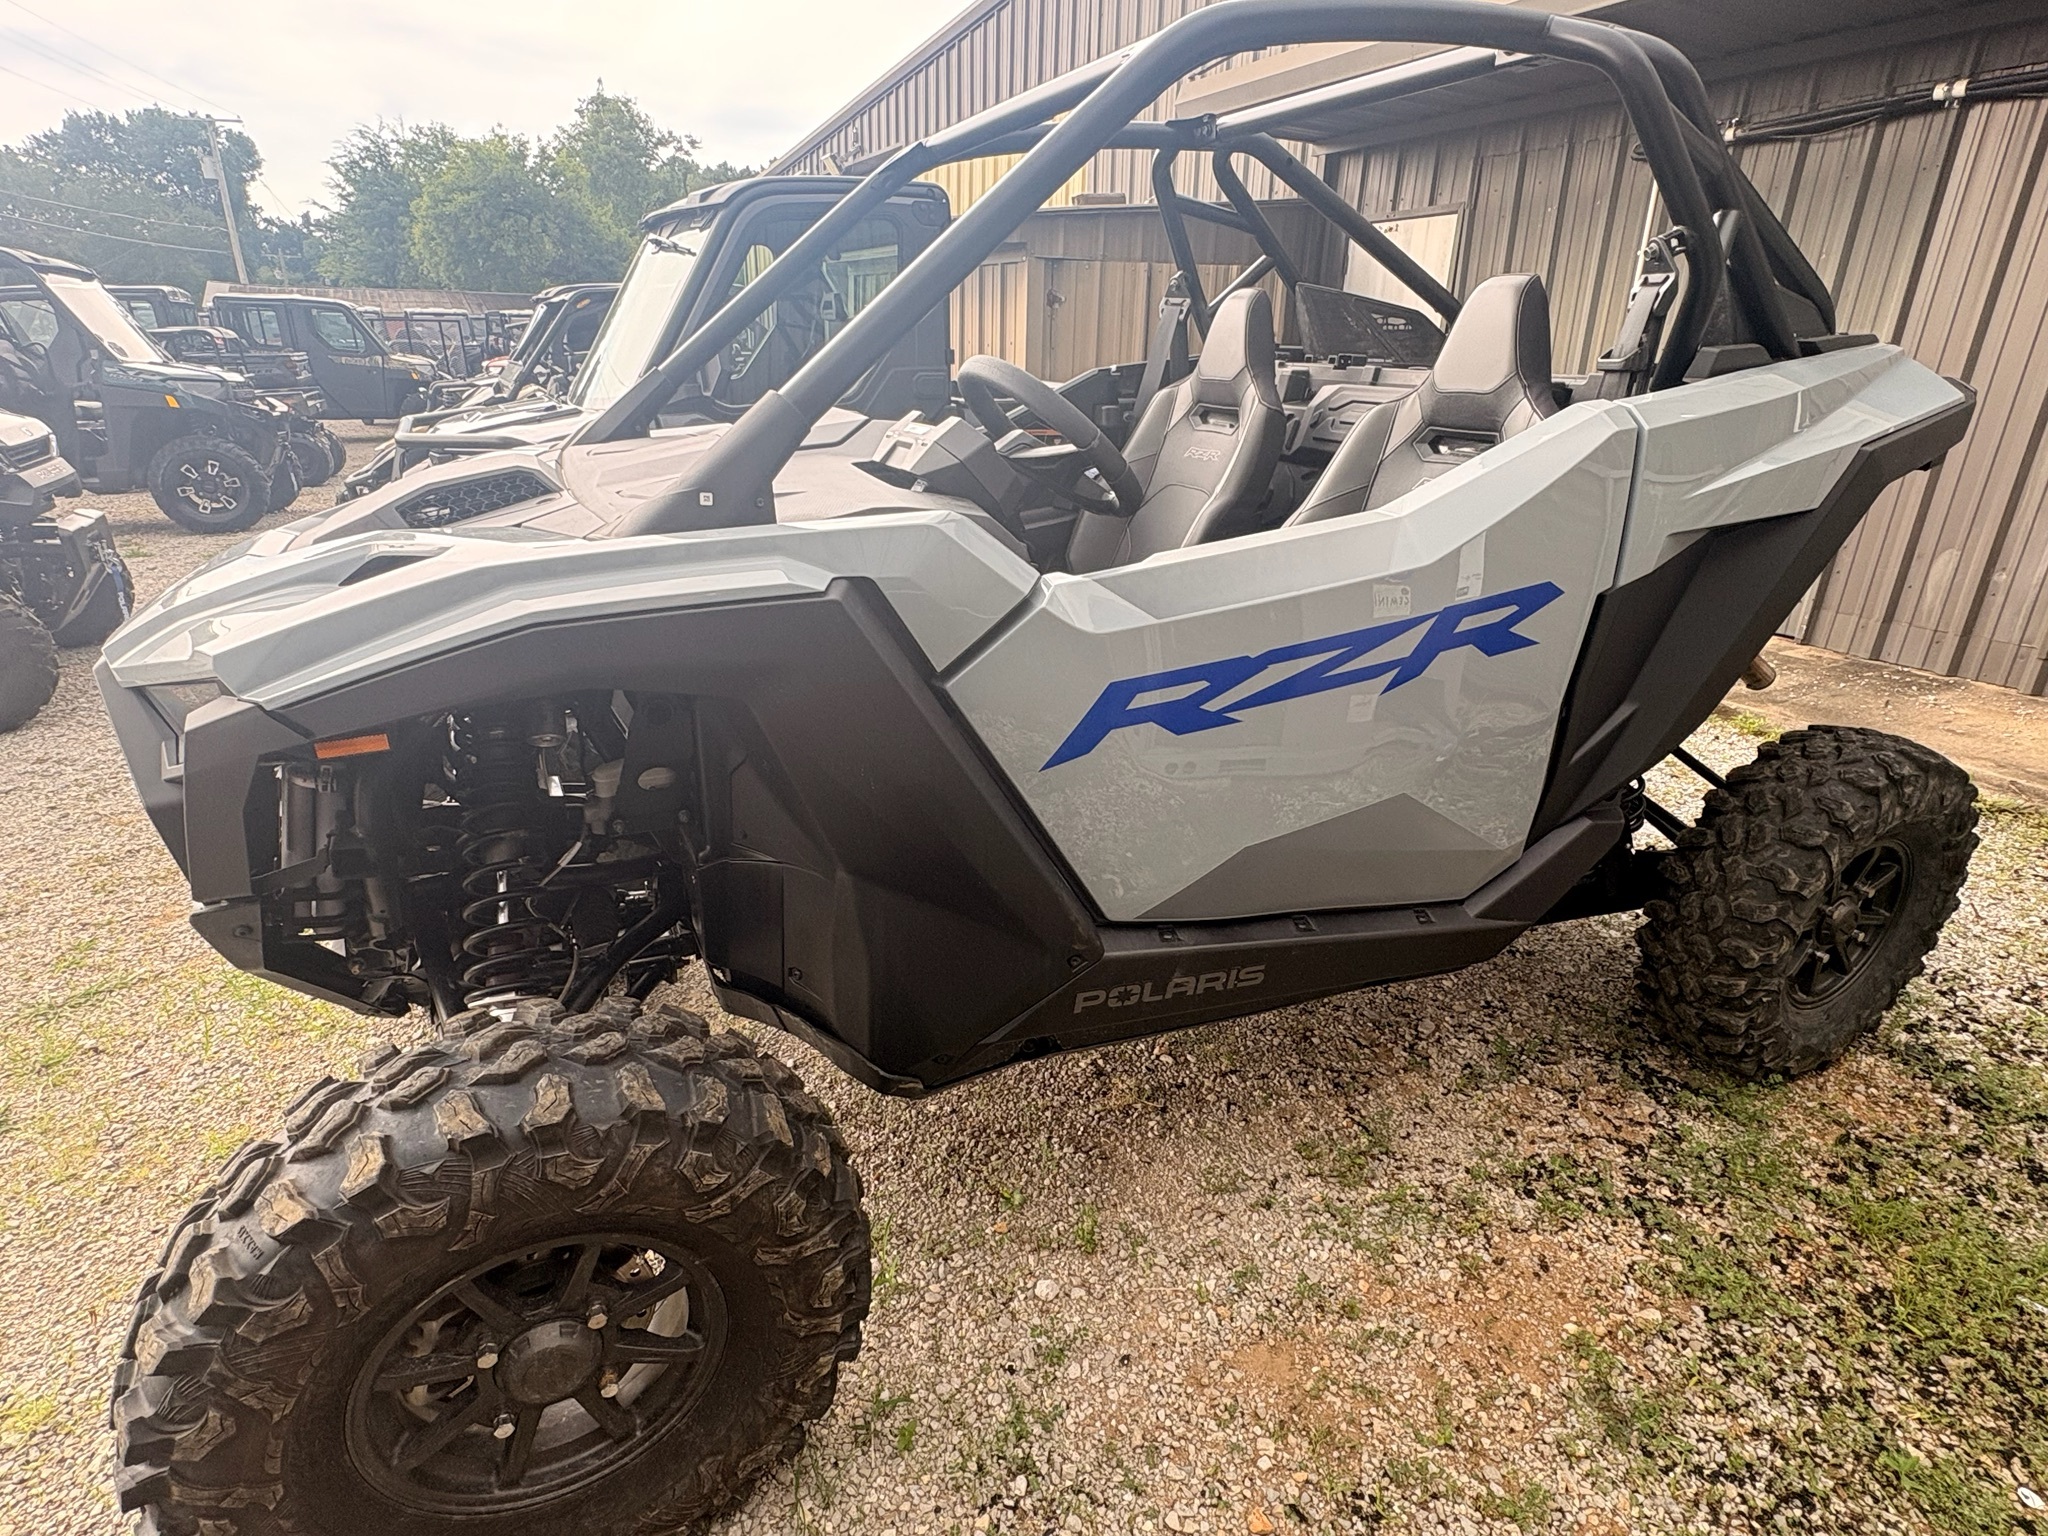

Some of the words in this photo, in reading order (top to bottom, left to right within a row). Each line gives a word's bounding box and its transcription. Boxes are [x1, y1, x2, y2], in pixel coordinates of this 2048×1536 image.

[1183, 446, 1221, 461] RZR
[1039, 581, 1565, 772] RZR
[1073, 964, 1266, 1014] POLARIS
